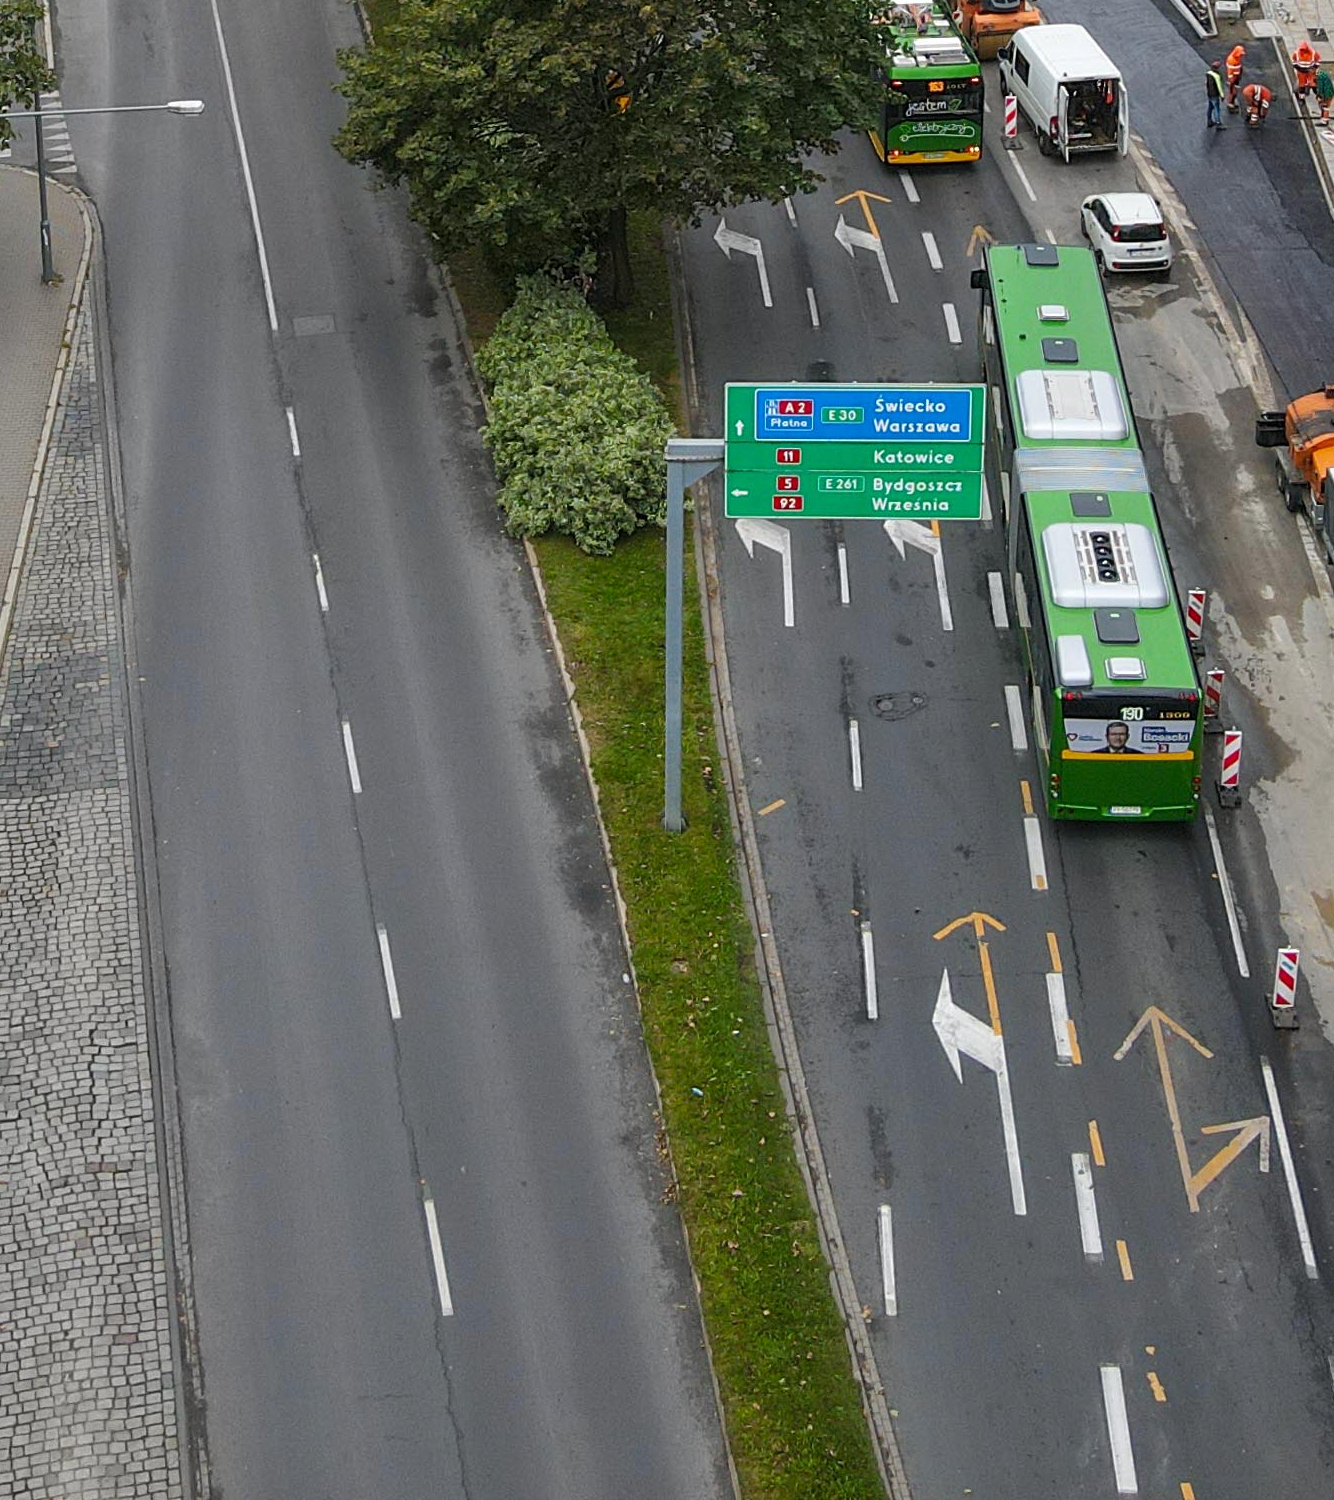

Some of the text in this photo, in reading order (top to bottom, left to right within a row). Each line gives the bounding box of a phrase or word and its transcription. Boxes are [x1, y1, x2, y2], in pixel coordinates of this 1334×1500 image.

[785, 402, 806, 413] A 2
[875, 394, 946, 413] Świecko
[828, 410, 857, 421] E 30
[770, 418, 808, 428] Płatna
[874, 418, 961, 433] Warszawa
[783, 451, 794, 462] 11
[874, 450, 955, 464] Katowice
[784, 478, 792, 490] 5
[825, 479, 857, 490] E 261
[873, 478, 963, 495] Bydgoszcz
[779, 498, 797, 509] 92
[872, 497, 949, 511] Września
